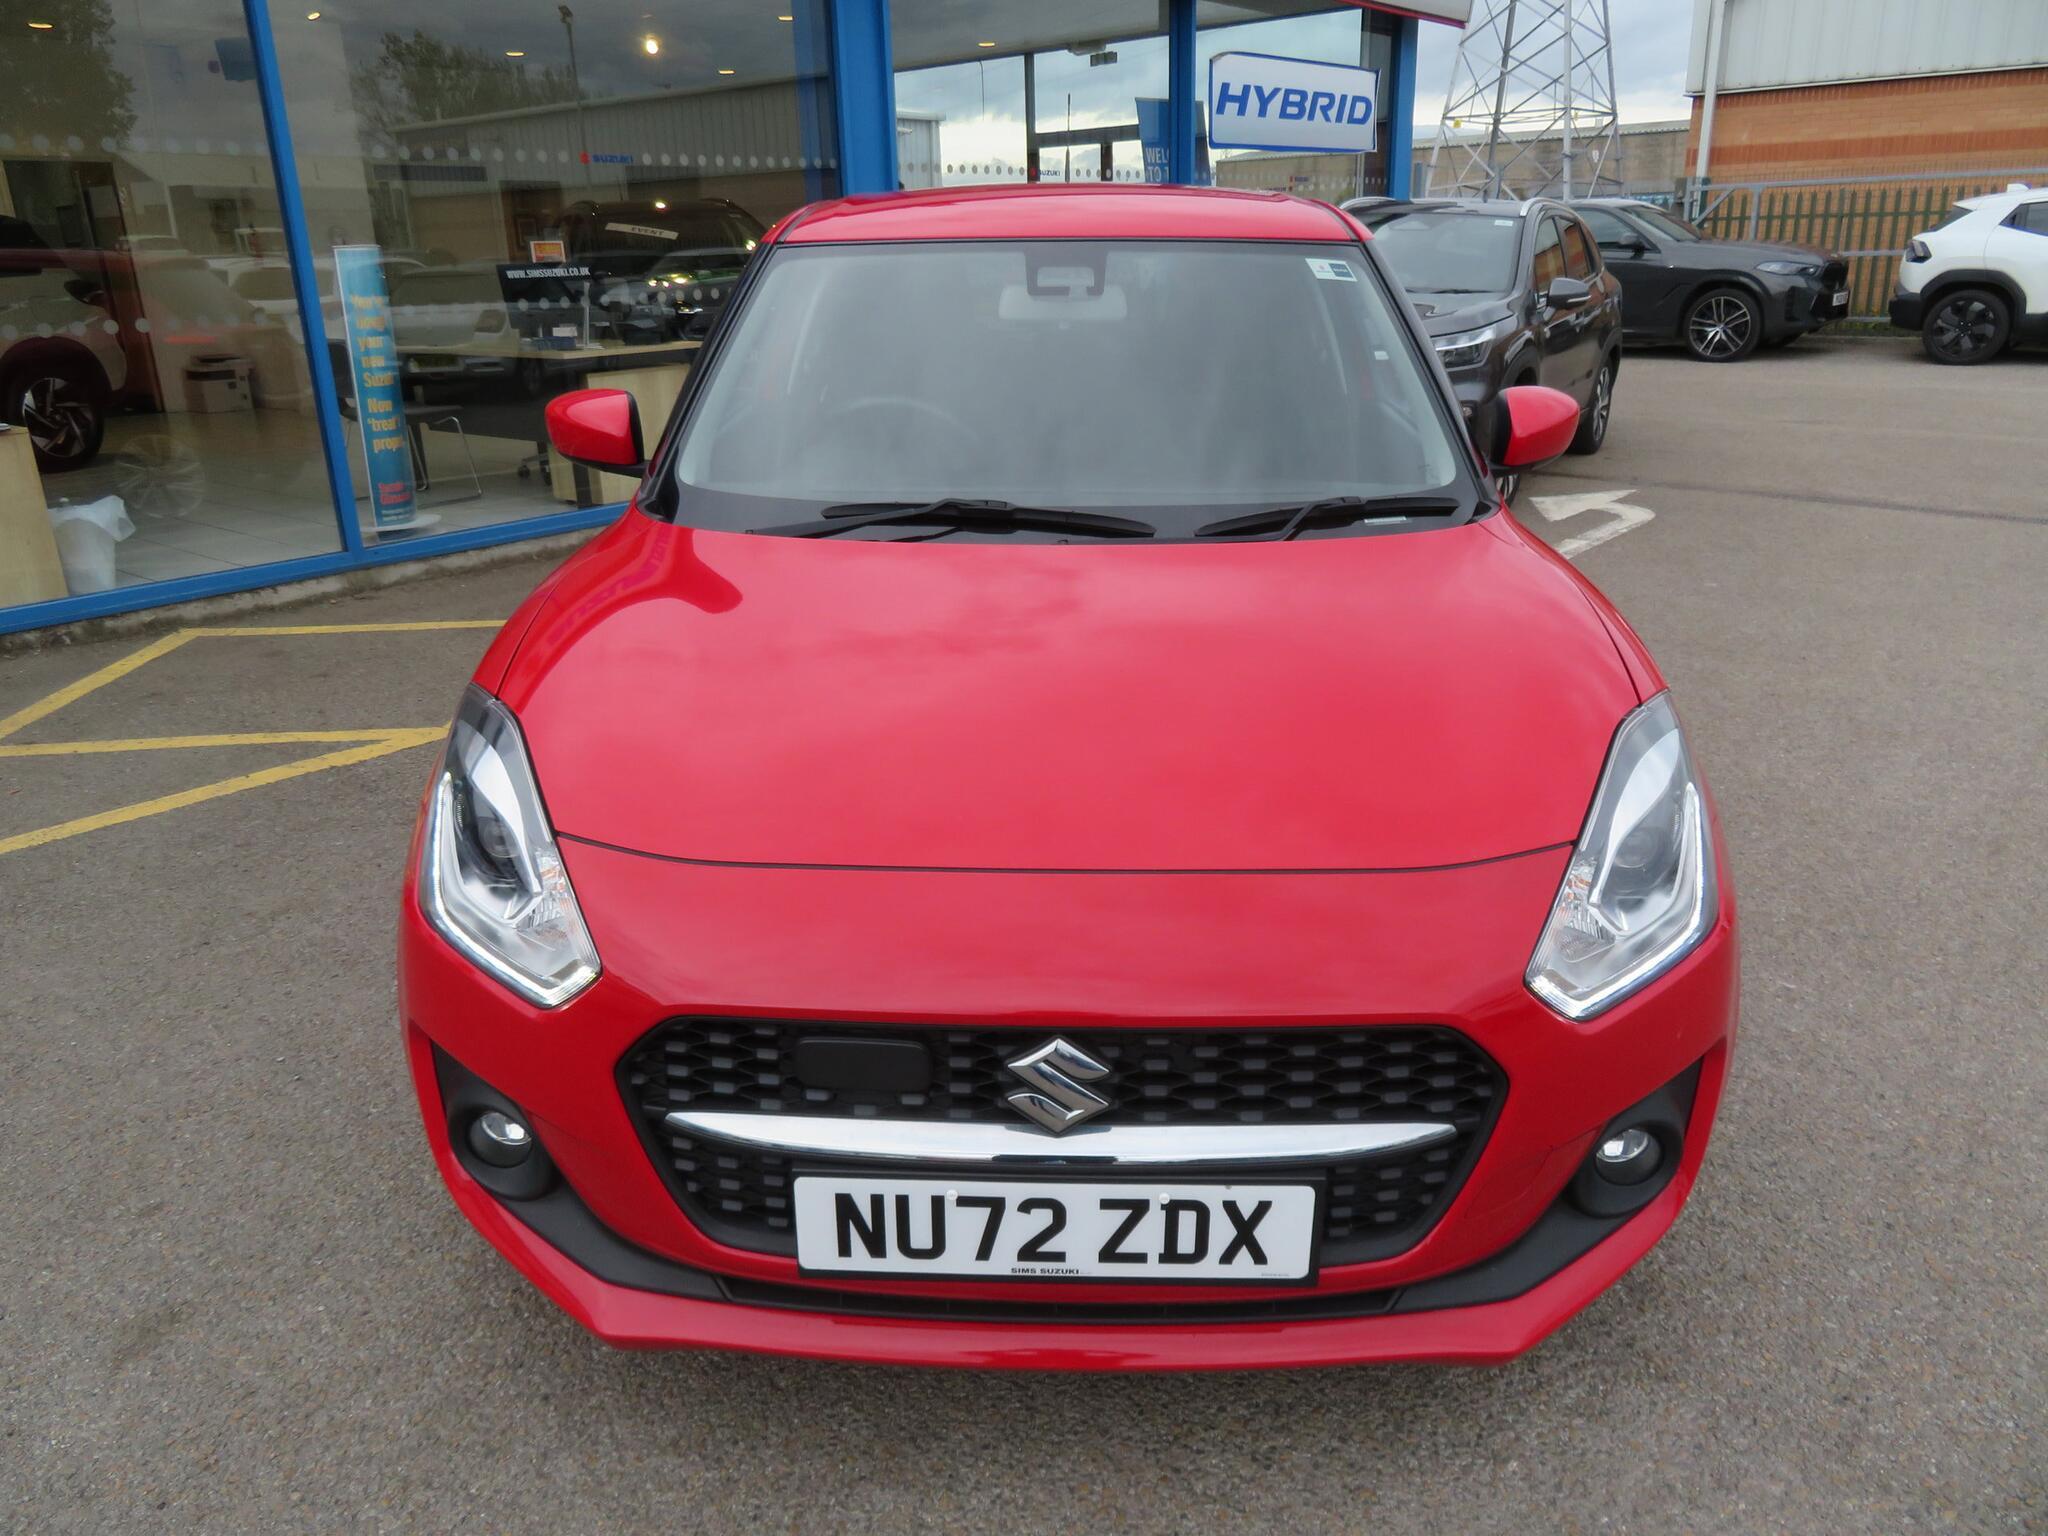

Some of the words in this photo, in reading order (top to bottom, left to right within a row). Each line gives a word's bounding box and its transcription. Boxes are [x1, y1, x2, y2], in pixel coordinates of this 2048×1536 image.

[1215, 82, 1373, 125] HYBRID
[592, 154, 634, 164] SUZUKI
[505, 267, 591, 279] WWW.SIMSSUZUKI.CO.UK
[835, 1192, 1067, 1263] NU72
[1098, 1198, 1274, 1266] ZDX
